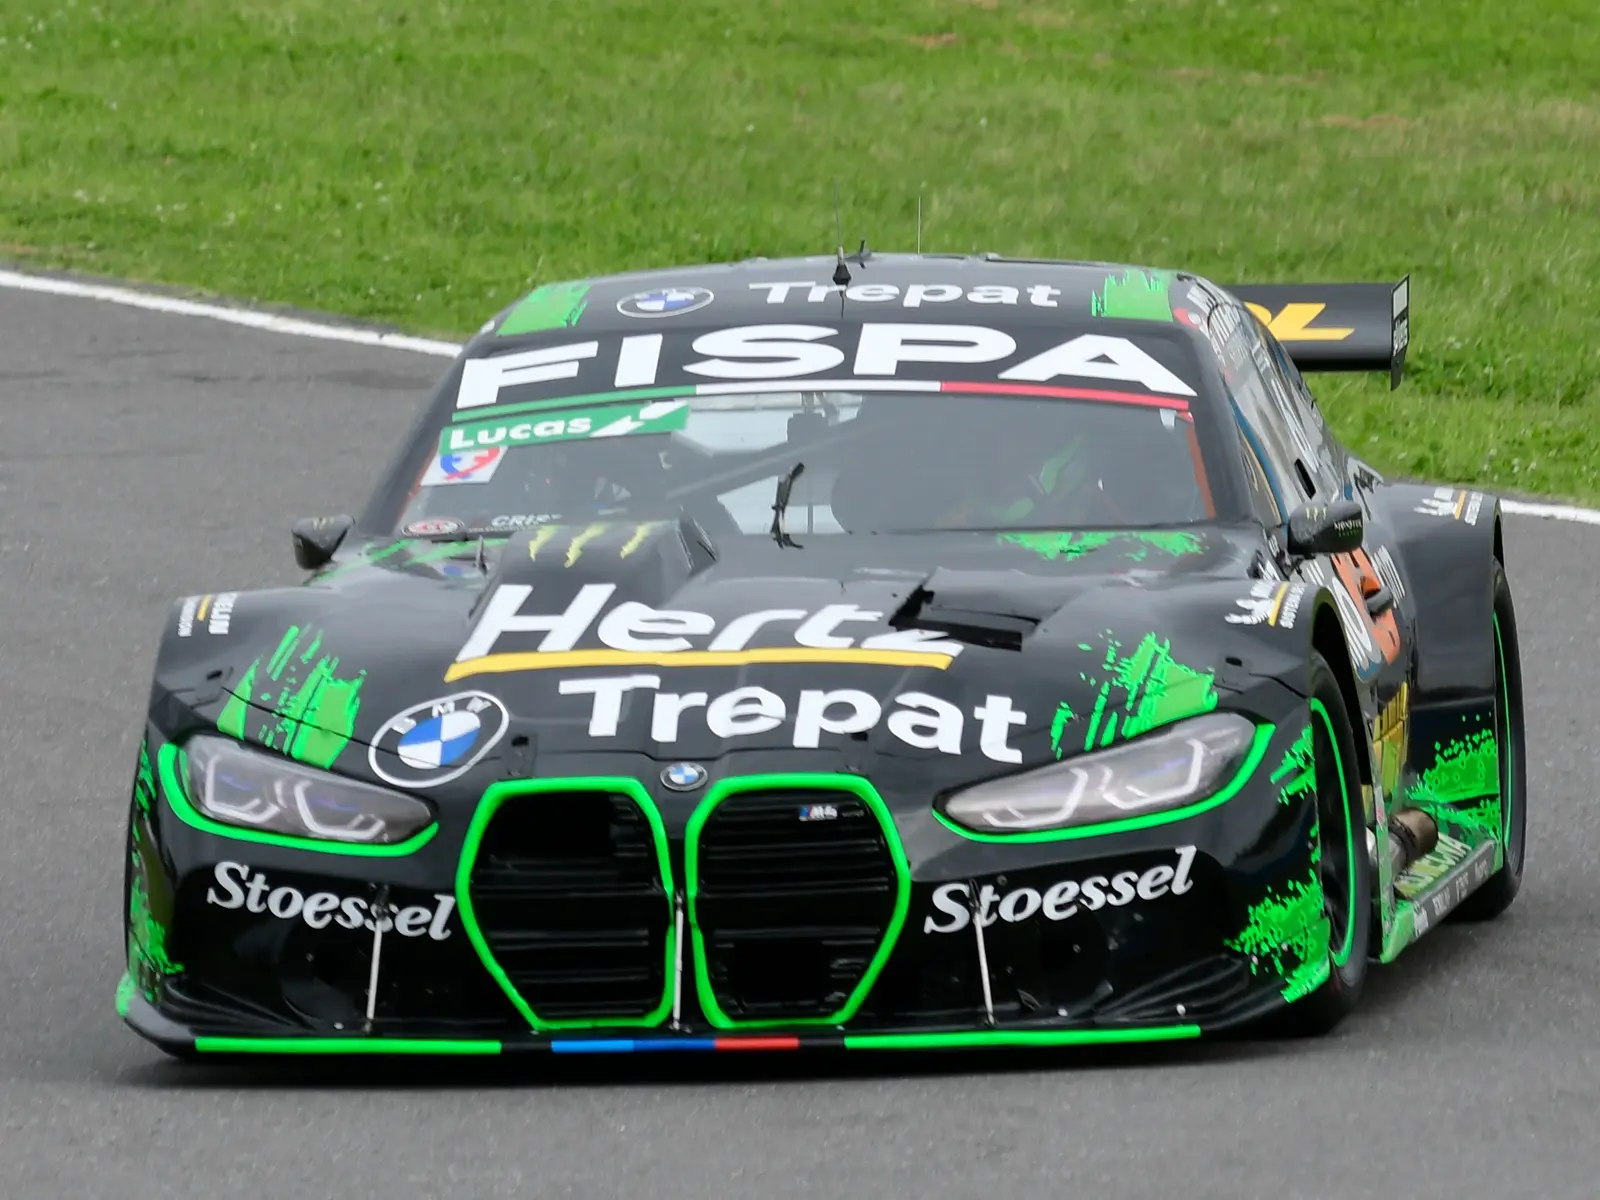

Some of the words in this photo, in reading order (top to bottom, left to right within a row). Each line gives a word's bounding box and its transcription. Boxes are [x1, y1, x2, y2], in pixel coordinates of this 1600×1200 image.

[749, 281, 1061, 308] Trepat
[456, 323, 1198, 409] FISPA
[449, 416, 592, 450] Lucas
[558, 674, 1026, 764] Trepat
[206, 861, 456, 941] Stoessel
[923, 845, 1197, 934] Stoessel
